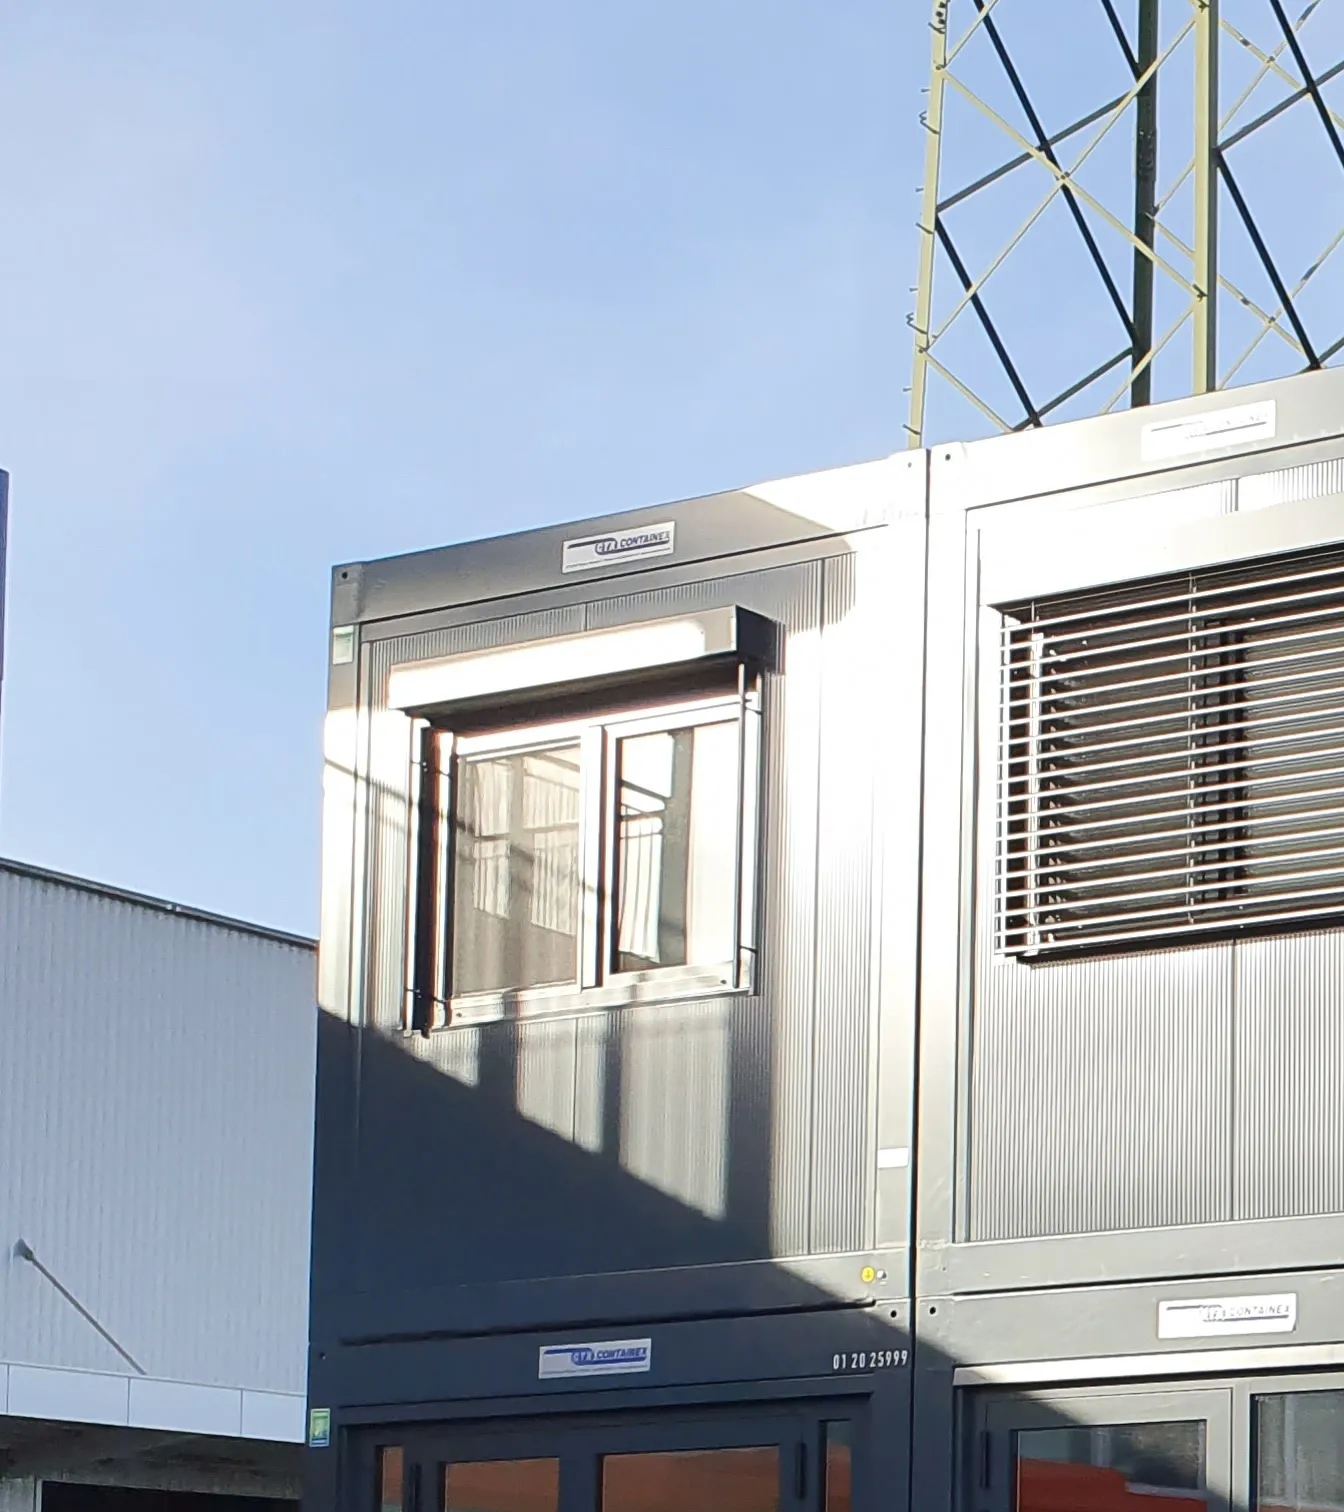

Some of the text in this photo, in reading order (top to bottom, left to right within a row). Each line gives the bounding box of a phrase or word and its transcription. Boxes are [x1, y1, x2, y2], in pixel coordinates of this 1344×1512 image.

[620, 531, 670, 549] CONTAINEX
[596, 1347, 649, 1359] CONTAINEX
[833, 1350, 908, 1370] 01 20 25999
